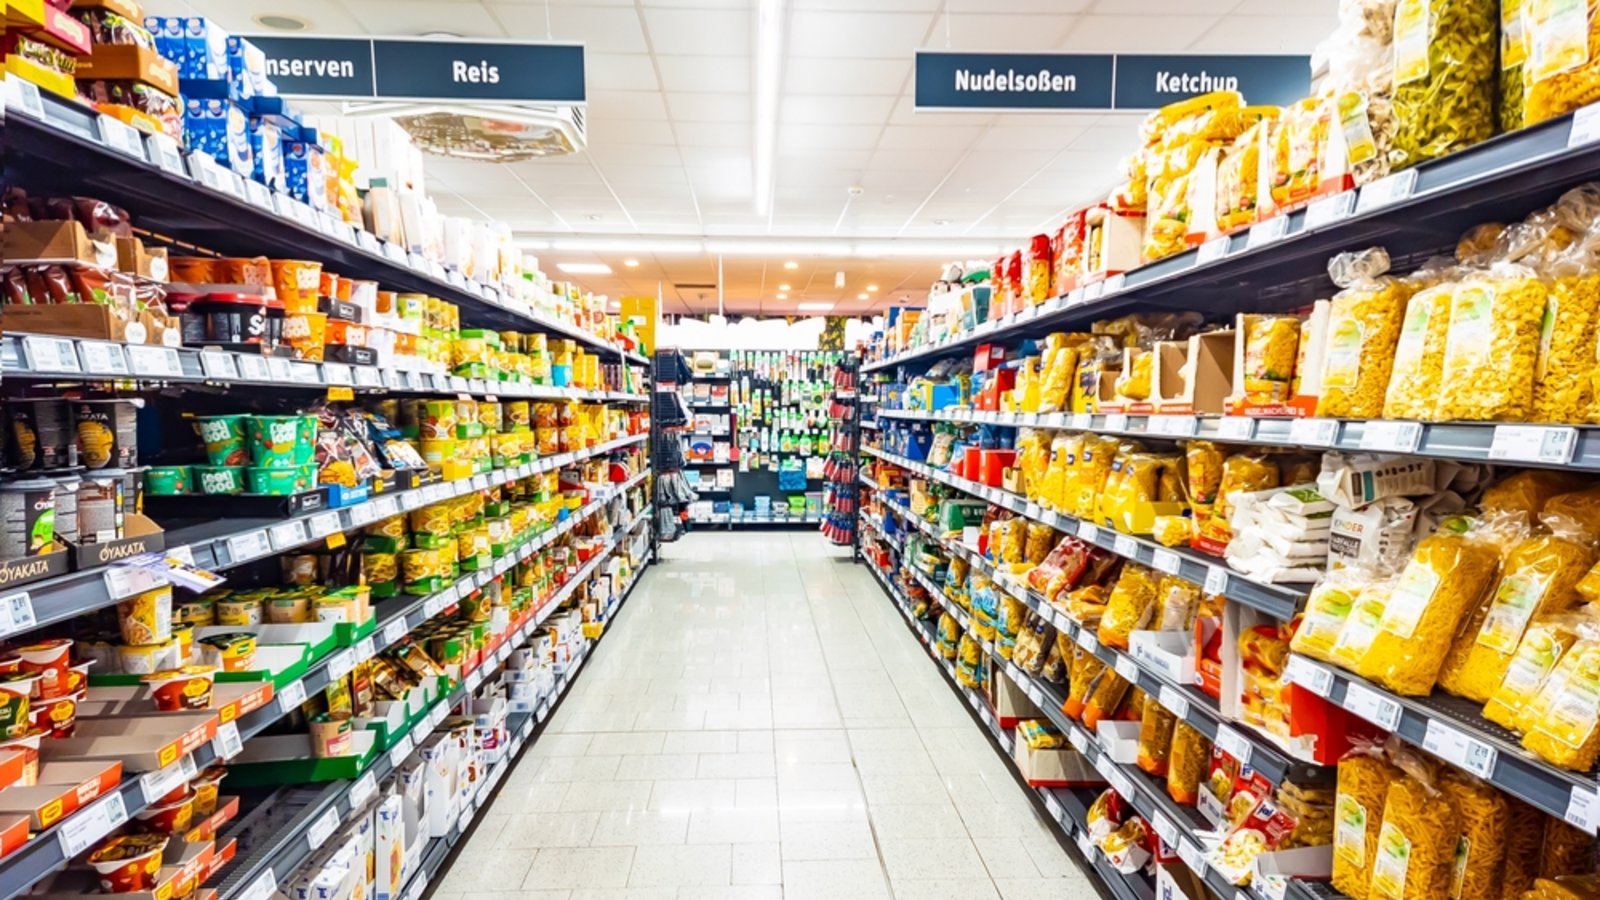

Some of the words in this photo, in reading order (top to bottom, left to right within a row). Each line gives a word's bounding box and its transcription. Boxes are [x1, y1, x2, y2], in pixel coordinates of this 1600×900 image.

[453, 60, 500, 83] Reis
[955, 69, 1076, 92] Nudelsoßen
[1156, 70, 1238, 93] Ketchup
